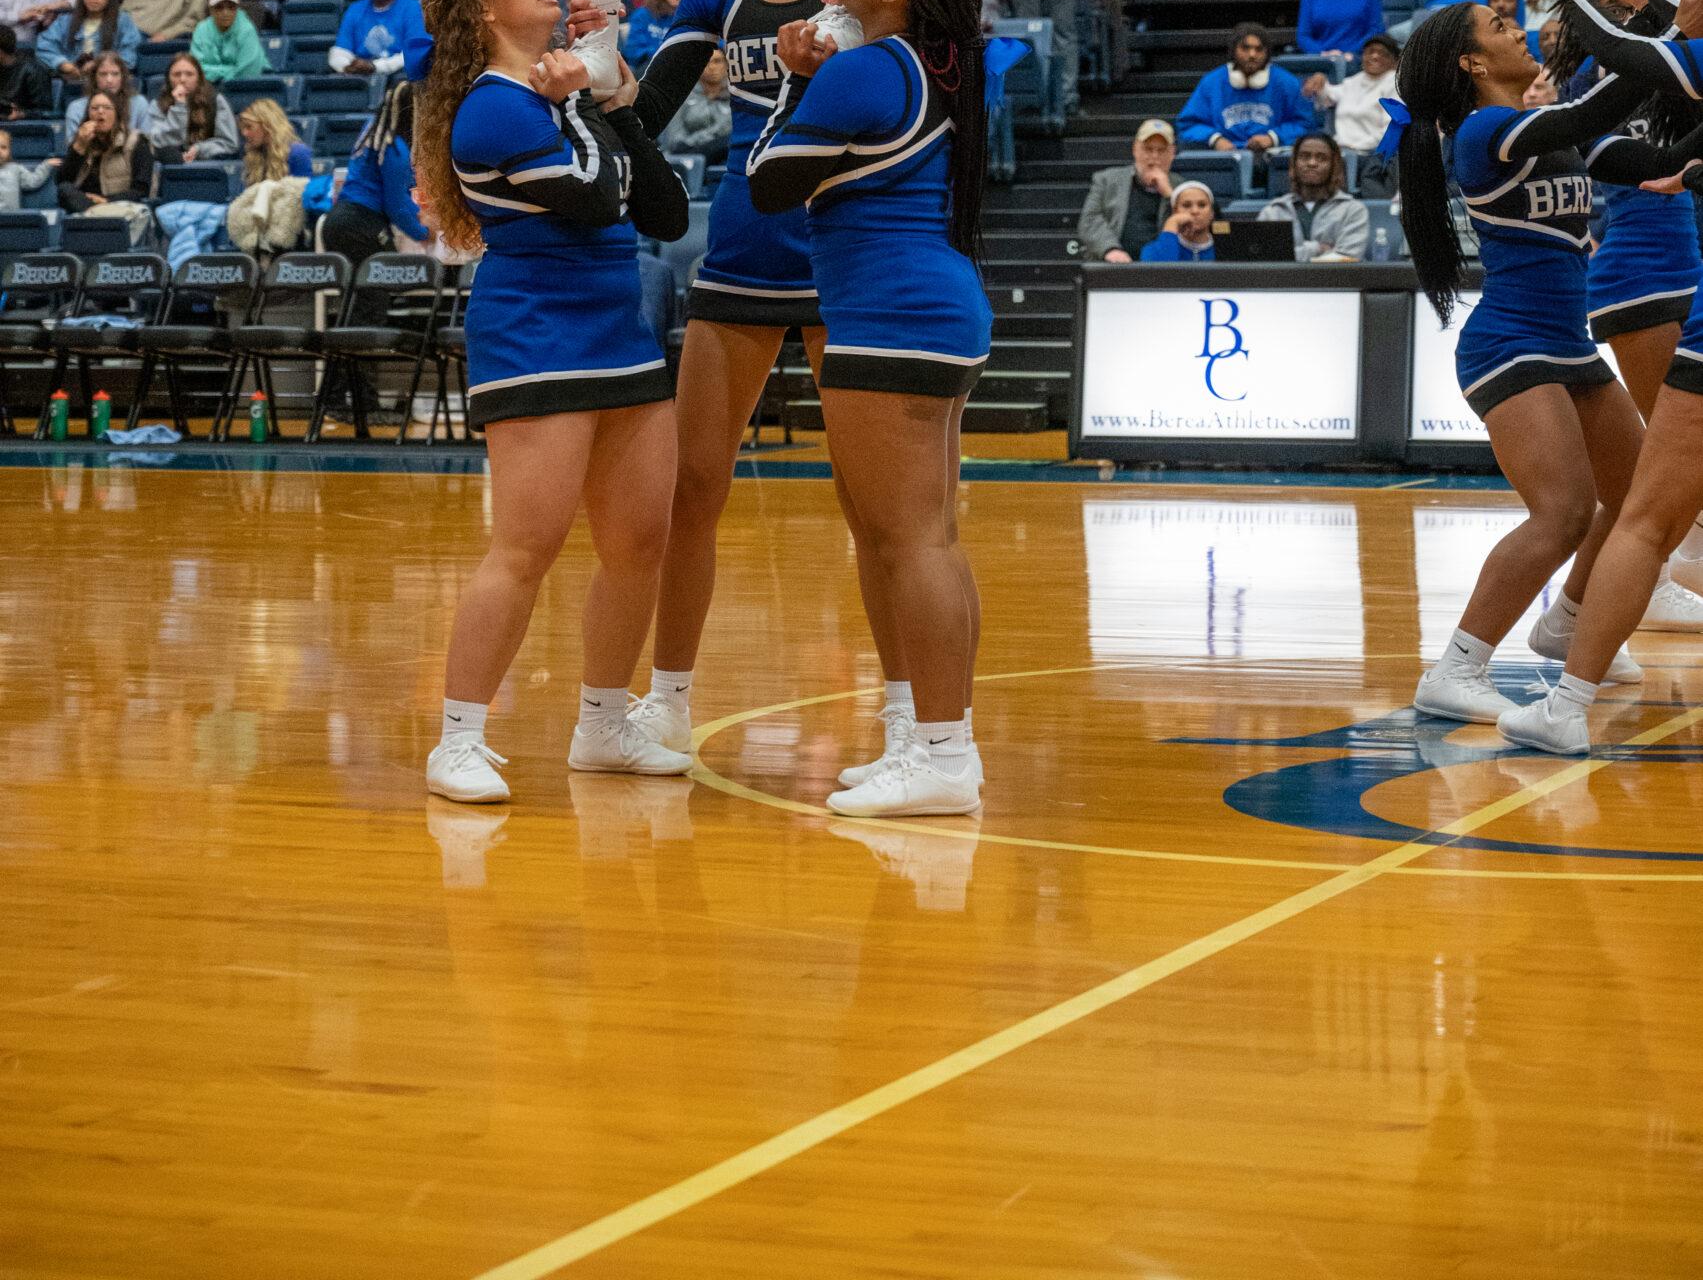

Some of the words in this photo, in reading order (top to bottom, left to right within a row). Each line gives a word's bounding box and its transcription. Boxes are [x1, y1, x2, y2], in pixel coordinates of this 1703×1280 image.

[726, 36, 790, 83] BER
[11, 262, 69, 284] BEREA
[96, 262, 155, 284] BEREA
[184, 262, 245, 284] BEREA
[276, 261, 337, 284] BEREA
[367, 261, 428, 284] BEREA
[1091, 410, 1351, 431] www.BereaAthletics.com
